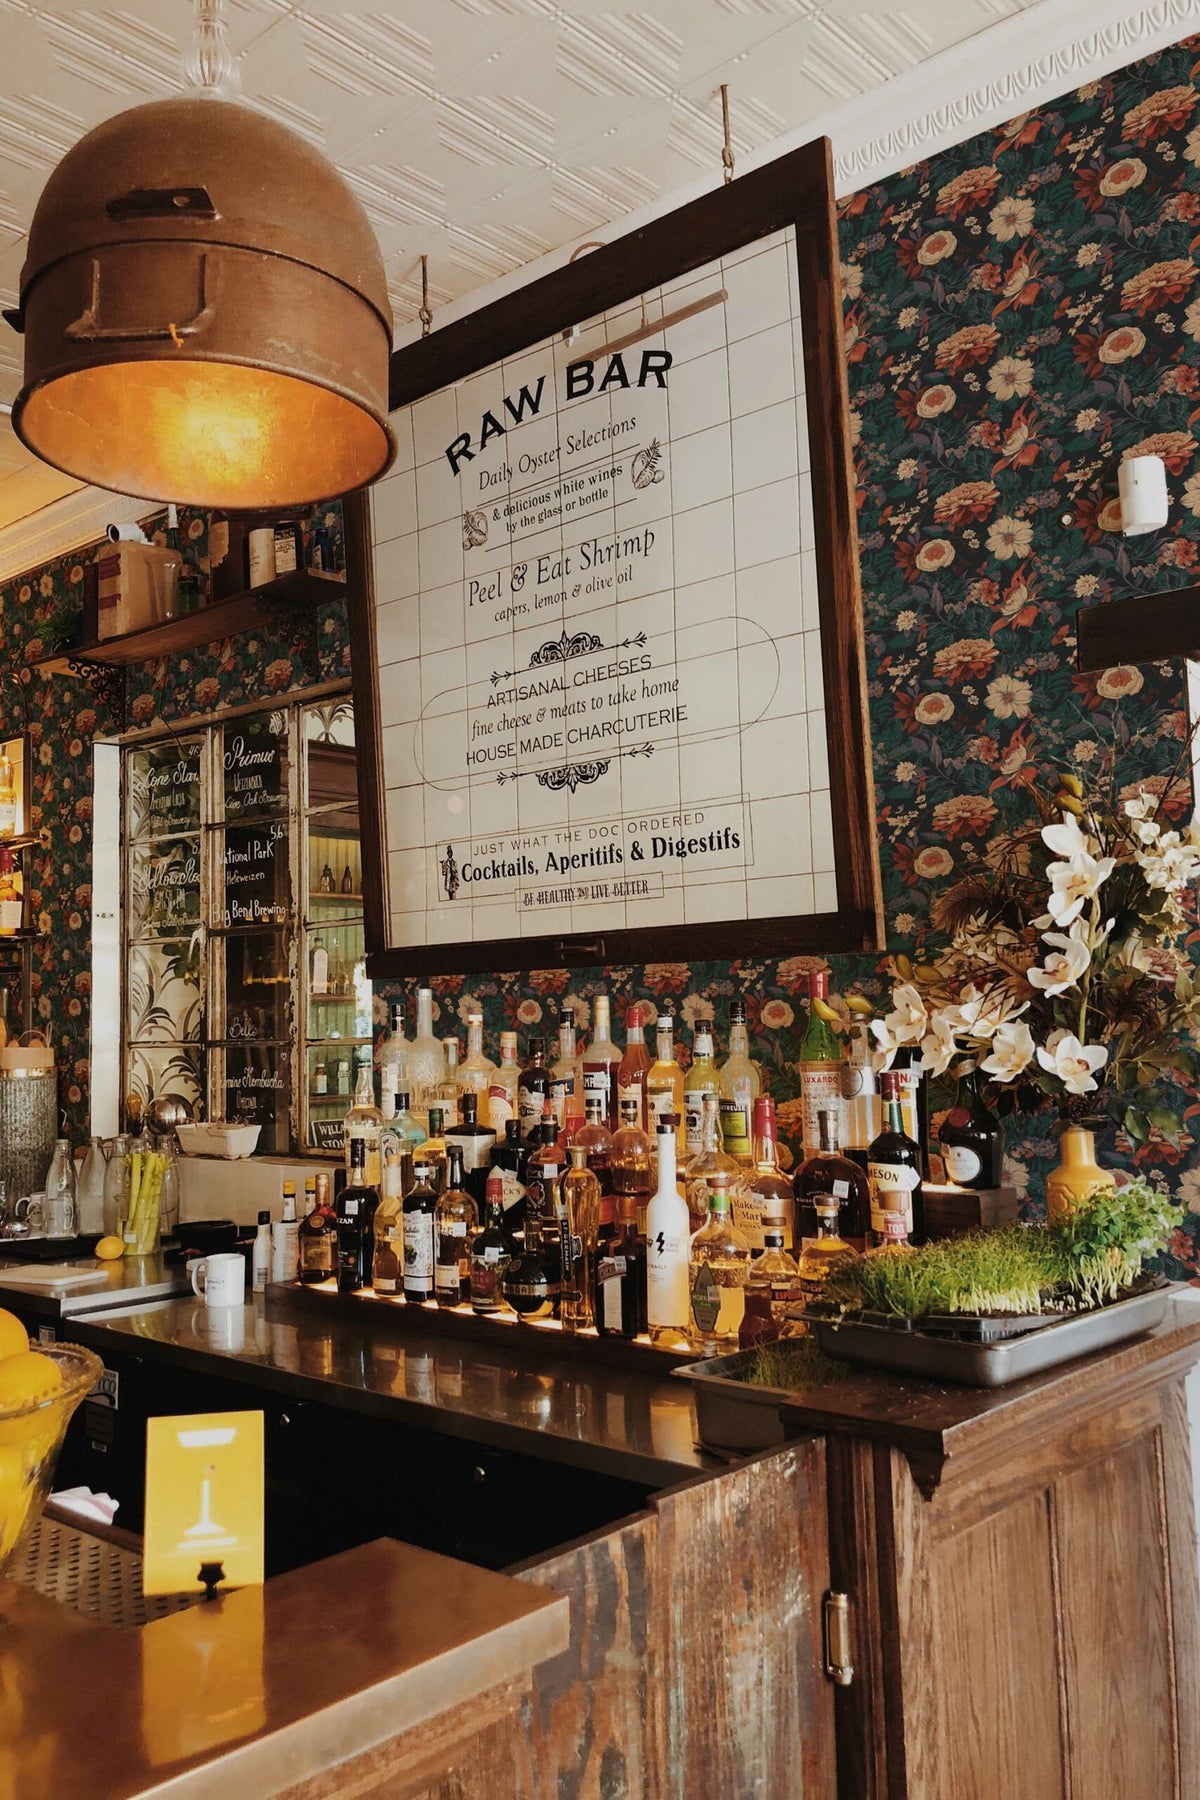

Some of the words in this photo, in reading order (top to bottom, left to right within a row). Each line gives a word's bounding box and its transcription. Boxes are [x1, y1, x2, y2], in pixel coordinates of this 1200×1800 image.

[445, 375, 547, 477] RAW
[565, 350, 673, 401] BAR
[479, 463, 513, 491] Daily
[518, 447, 561, 474] Oyster
[566, 416, 637, 455] Selections
[492, 508, 502, 521] &
[503, 492, 551, 518] delicious
[553, 479, 585, 500] white
[588, 465, 623, 486] wines
[506, 521, 517, 533] by
[520, 514, 536, 528] the
[537, 504, 563, 524] glass
[565, 500, 576, 512] or
[578, 487, 609, 507] bottle
[468, 571, 503, 607] Peel
[510, 563, 528, 592] &
[537, 555, 571, 585] Eat
[579, 528, 655, 571] Shrimp
[494, 601, 530, 622] capers,
[534, 589, 568, 609] lemon
[571, 584, 582, 597] &
[585, 574, 613, 594] olive
[616, 564, 633, 584] oil
[472, 720, 493, 741] fine
[497, 713, 532, 732] cheese
[536, 707, 546, 723] &
[550, 699, 586, 720] meats
[591, 694, 603, 709] to
[608, 684, 637, 707] take
[641, 678, 679, 699] home
[487, 676, 570, 709] ARTISANAL
[573, 654, 651, 687] CHEESES
[224, 736, 276, 770] Primus
[466, 742, 516, 766] HOUSE
[520, 732, 564, 755] MADE
[567, 705, 688, 744] CHARCUTERIE
[461, 855, 539, 883] Cocktails,
[545, 843, 624, 875] Aperitifs
[630, 840, 645, 860] &
[651, 827, 741, 859] Digestifs
[473, 841, 505, 857] JUST
[510, 835, 549, 850] WHAT
[555, 830, 581, 845] THE
[589, 825, 619, 840] DOC
[627, 812, 705, 833] ORDERED
[232, 900, 253, 919] Bend
[254, 899, 286, 920] Brewing
[523, 892, 534, 906] BE
[536, 888, 576, 905] HEALTHY
[591, 884, 611, 899] LIVE
[612, 879, 649, 897] BETTER
[803, 1076, 838, 1084] LUXARDO
